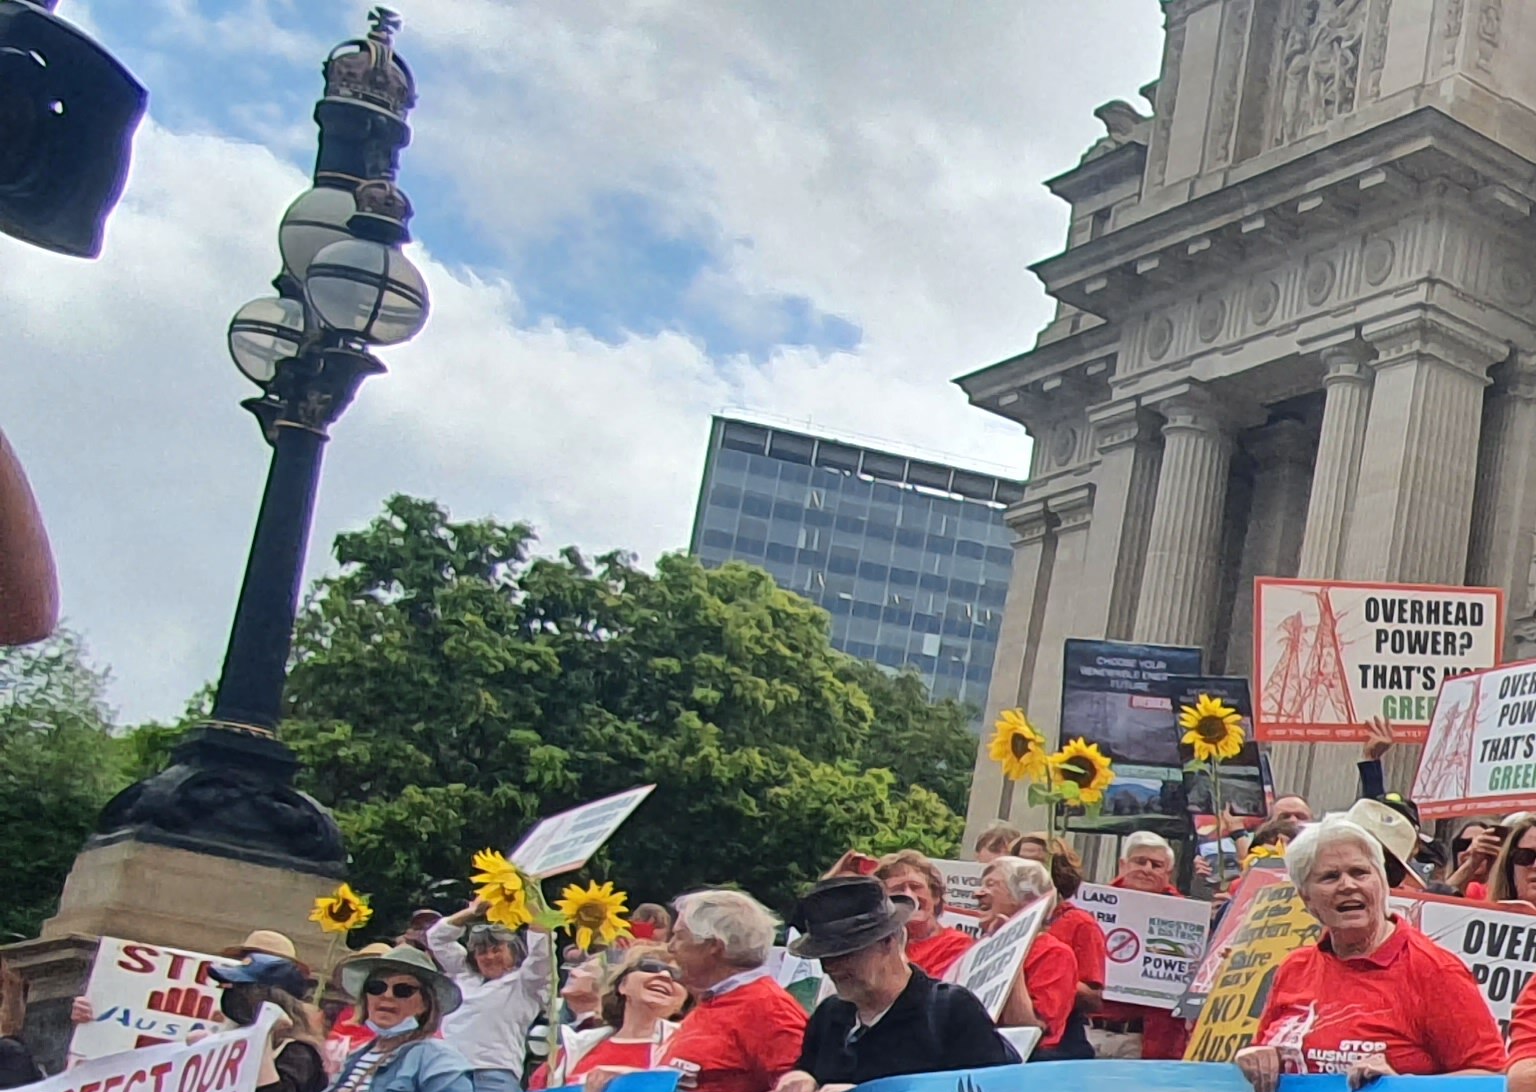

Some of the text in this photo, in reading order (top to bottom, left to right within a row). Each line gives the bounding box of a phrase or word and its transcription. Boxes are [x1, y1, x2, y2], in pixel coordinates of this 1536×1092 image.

[1364, 597, 1483, 627] OVERHEAD
[1375, 629, 1473, 657] POWER?
[1358, 663, 1438, 691] THAT'S
[1479, 733, 1534, 763] THAT'S
[1083, 890, 1118, 905] LAND
[1204, 994, 1245, 1025] NO
[1339, 1041, 1386, 1052] STOP
